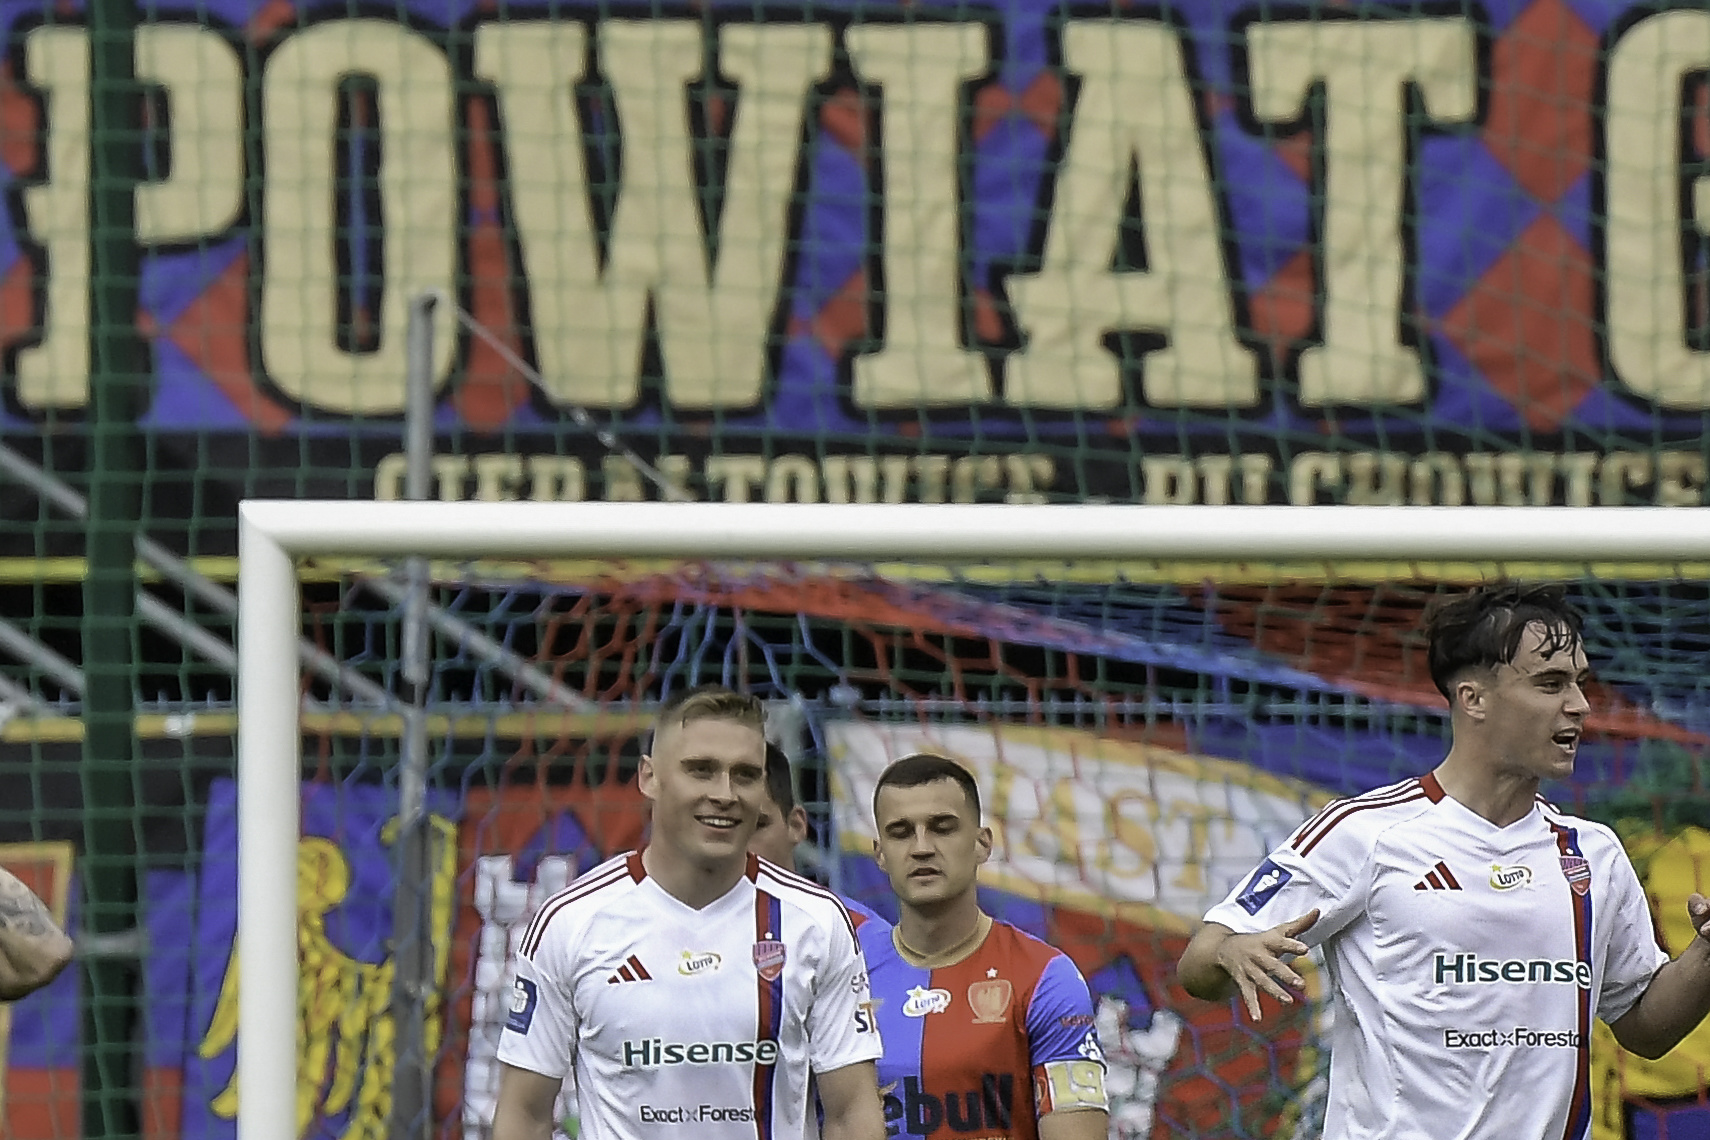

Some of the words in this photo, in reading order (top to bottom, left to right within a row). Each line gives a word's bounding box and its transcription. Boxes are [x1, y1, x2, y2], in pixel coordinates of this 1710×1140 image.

[15, 16, 1477, 414] POWIAT
[1436, 953, 1591, 987] Hisense
[623, 1039, 778, 1066] Hisense
[883, 1073, 1013, 1136] ebull
[1052, 1061, 1104, 1107] 19
